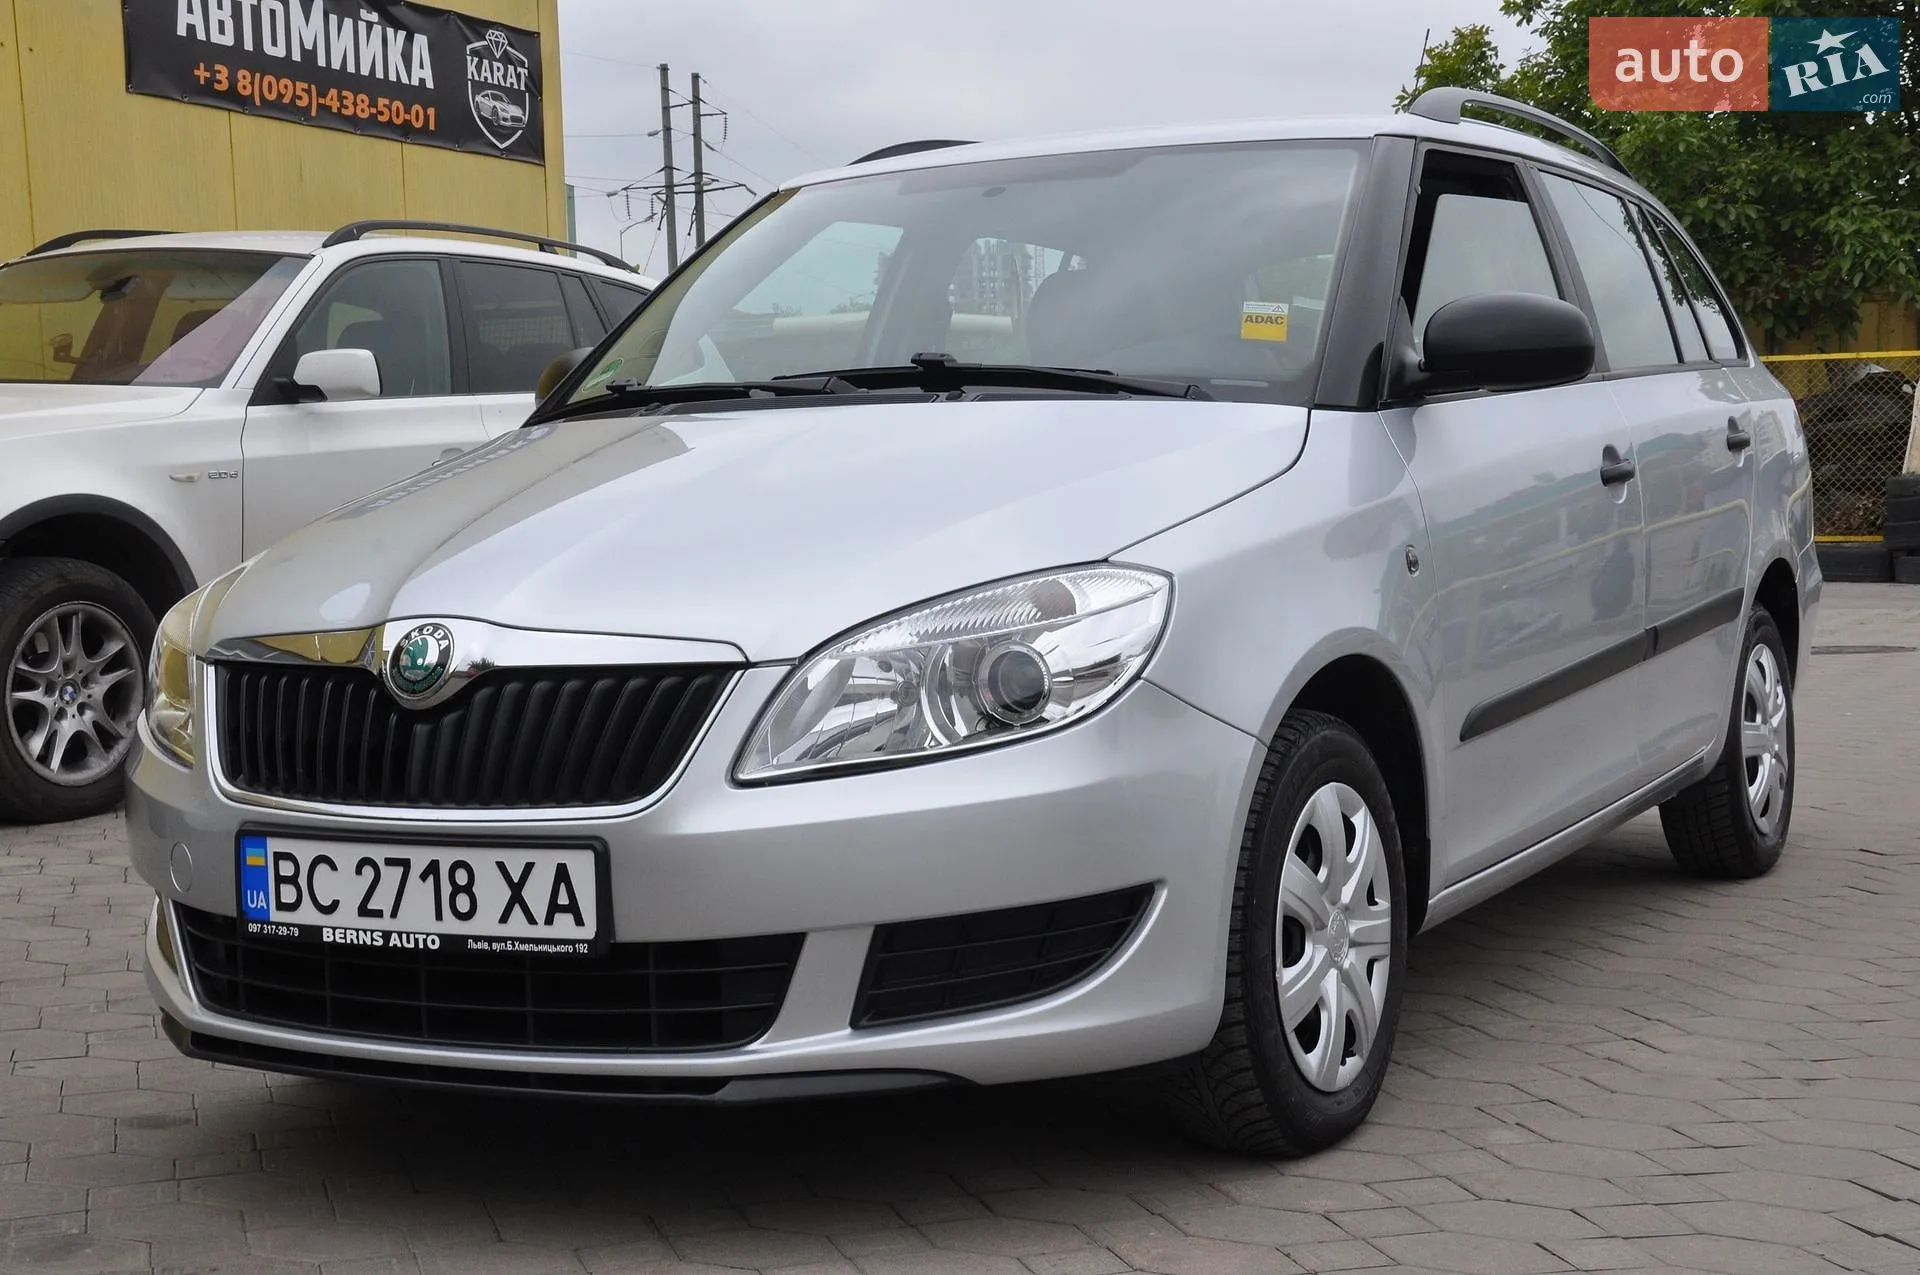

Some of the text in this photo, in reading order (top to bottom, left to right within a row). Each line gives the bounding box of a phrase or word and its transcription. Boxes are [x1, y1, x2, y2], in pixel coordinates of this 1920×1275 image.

[466, 55, 528, 91] KARAT
[193, 62, 436, 130] +3 8(095)-438-50-01
[1244, 314, 1284, 325] ADAC
[247, 889, 267, 909] UA
[272, 851, 586, 927] BC 2718 XA
[248, 922, 299, 937] 097 317-29-79
[322, 927, 441, 950] BERNS AUTO
[575, 943, 588, 954] 192
